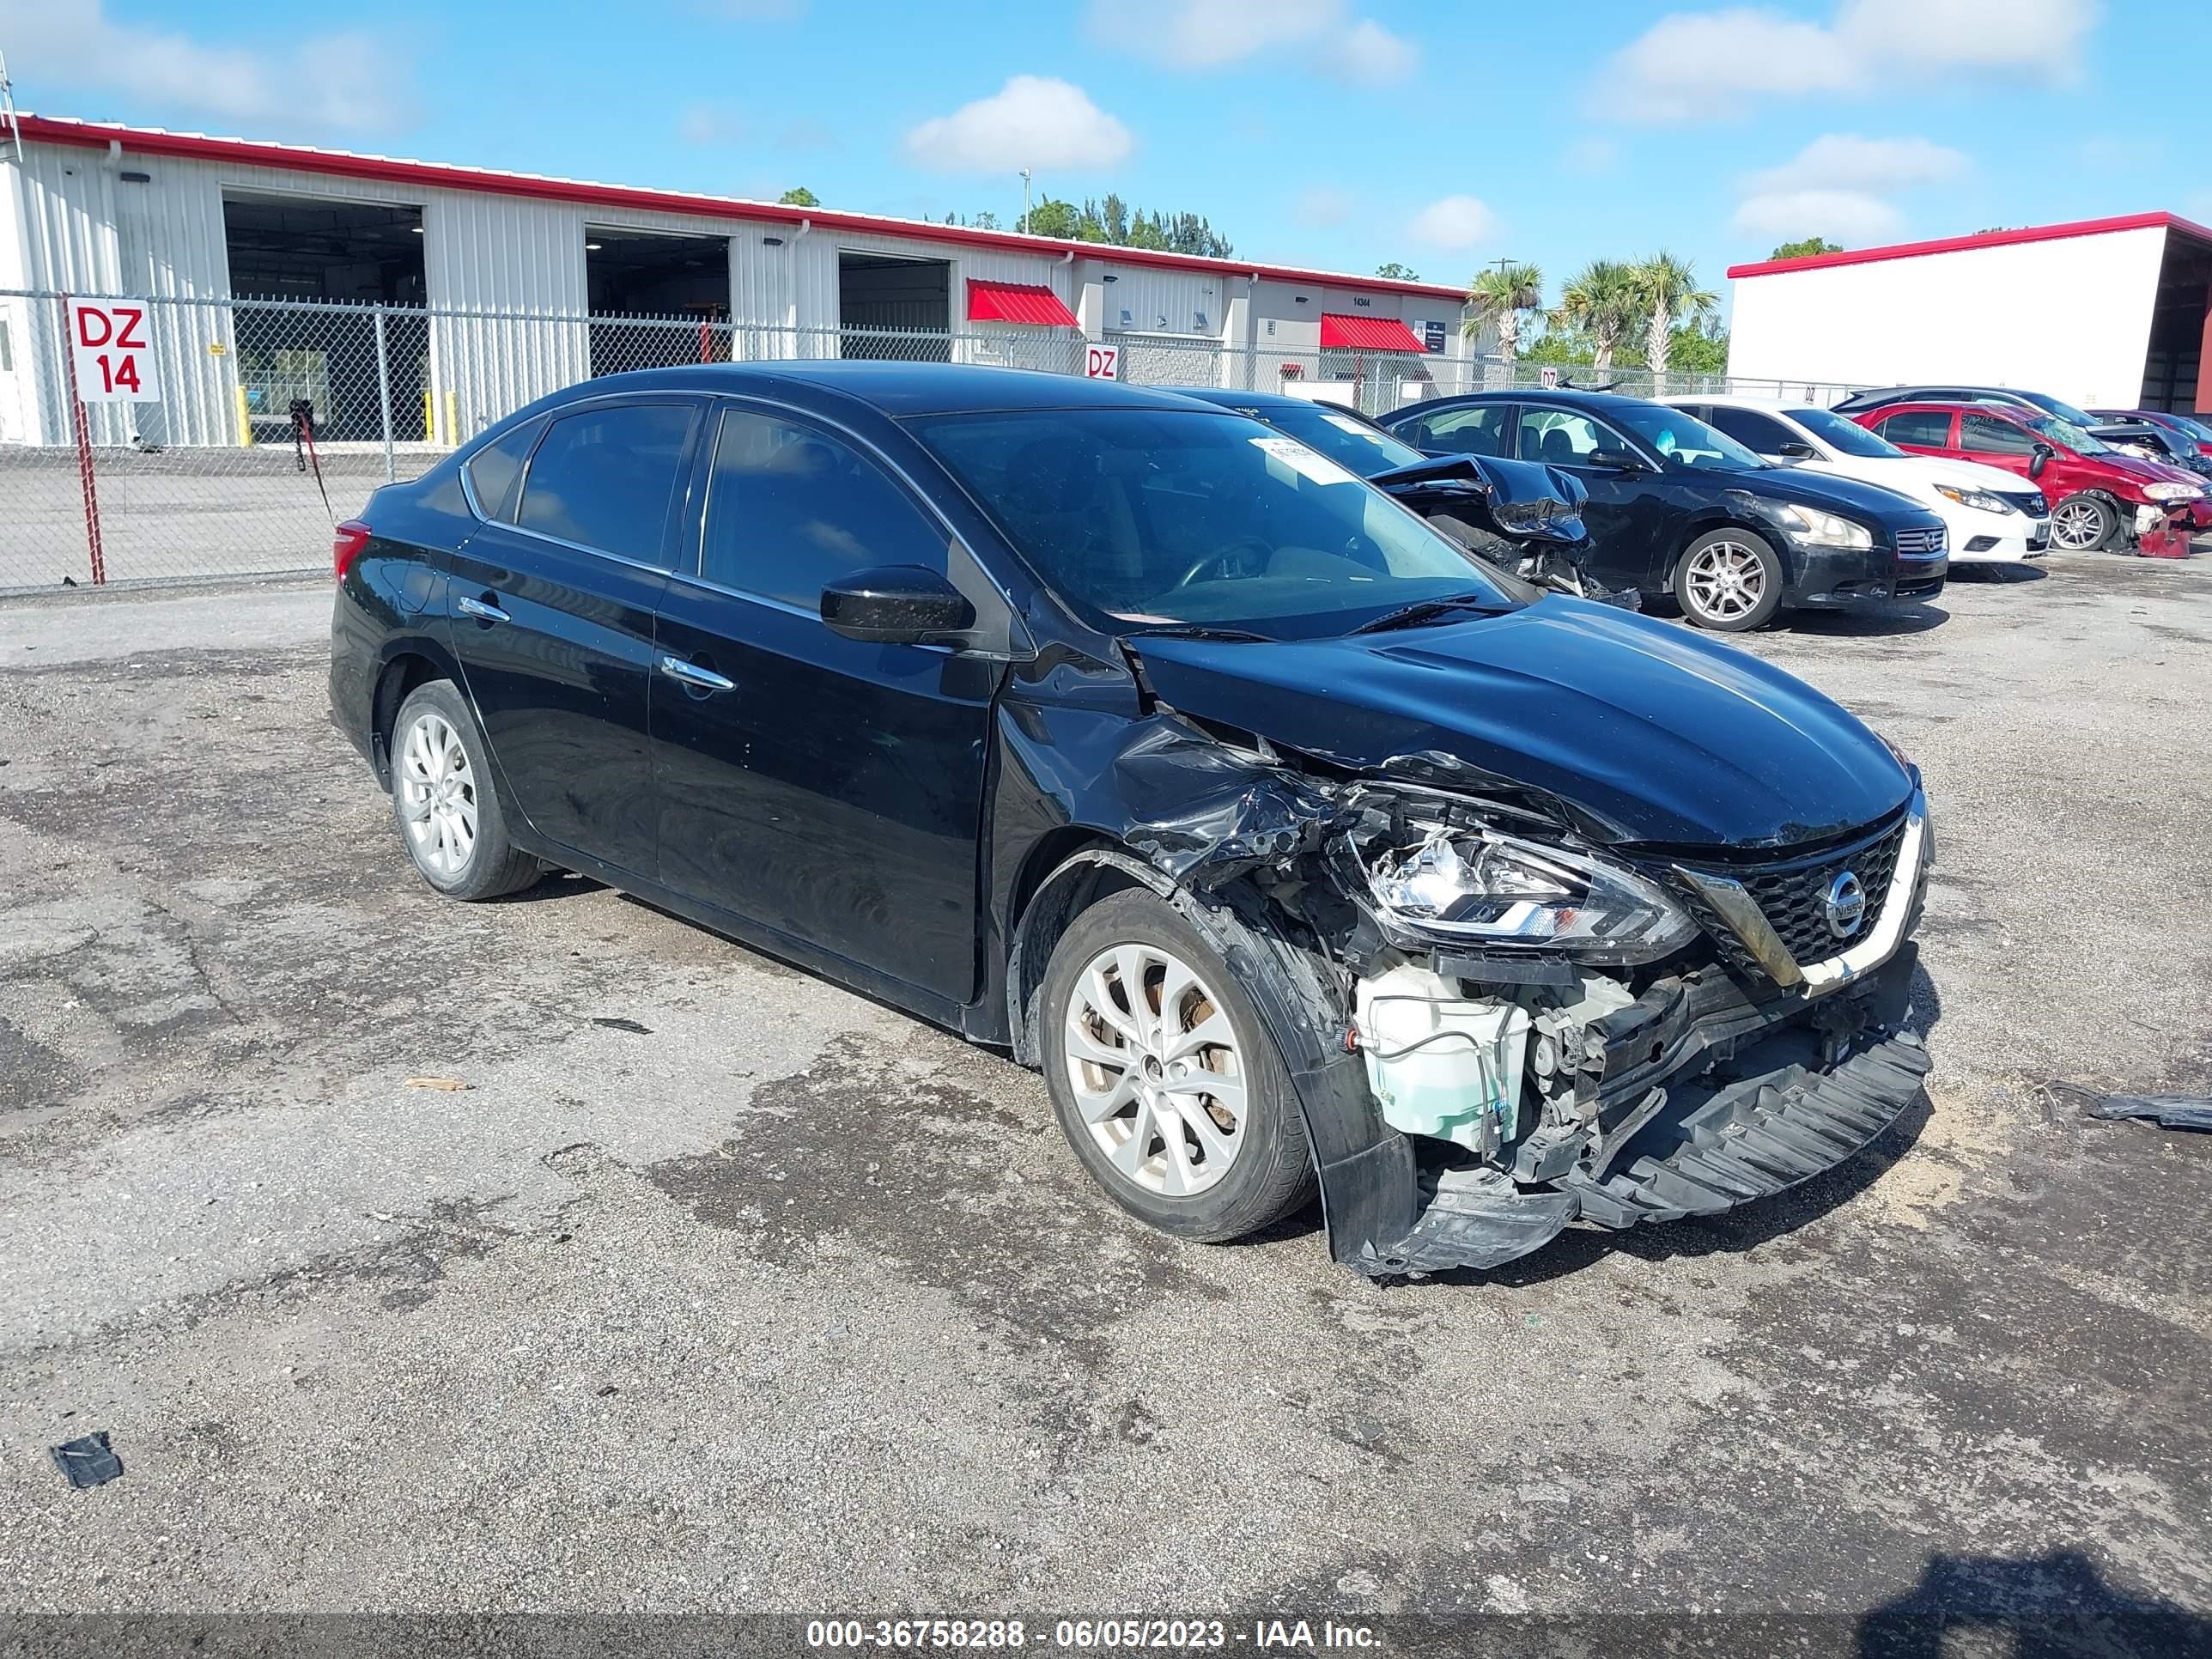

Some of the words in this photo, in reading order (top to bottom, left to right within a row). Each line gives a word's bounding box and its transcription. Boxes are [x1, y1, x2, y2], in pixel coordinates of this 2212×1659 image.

[77, 307, 146, 349] DZ
[96, 355, 141, 393] 14
[1089, 349, 1115, 377] DZ
